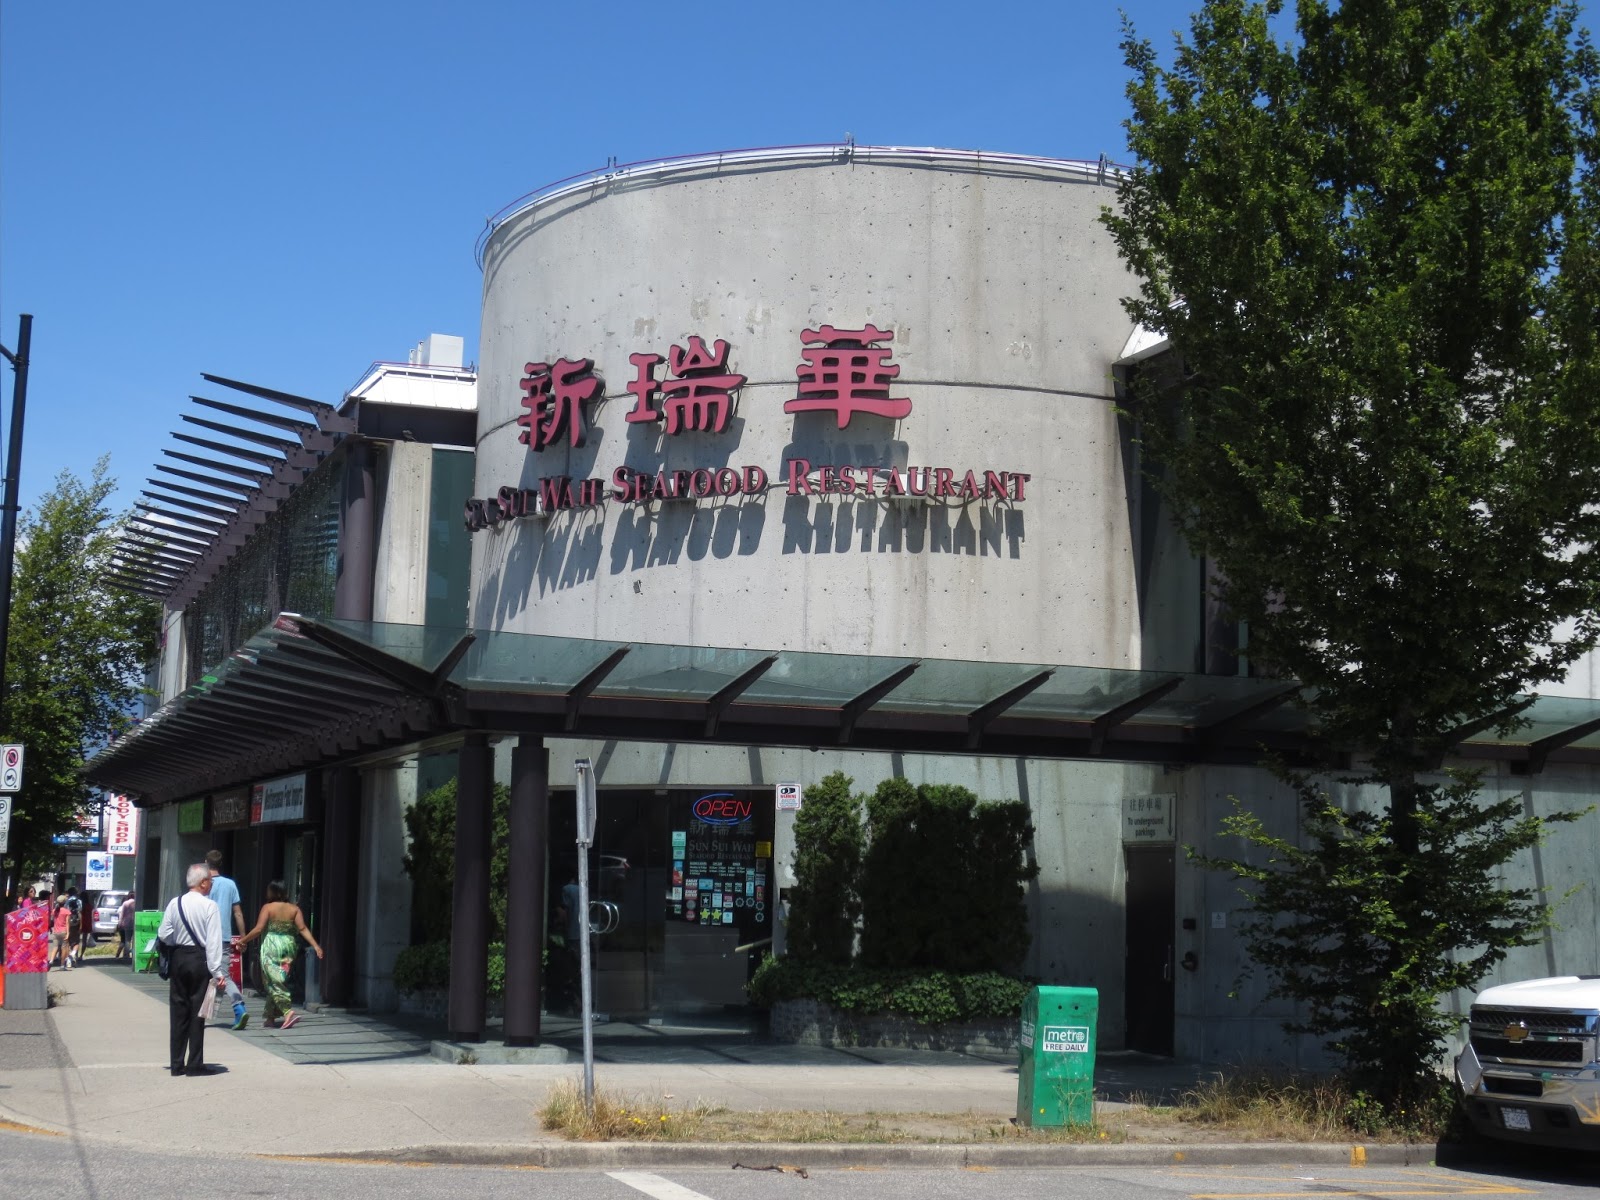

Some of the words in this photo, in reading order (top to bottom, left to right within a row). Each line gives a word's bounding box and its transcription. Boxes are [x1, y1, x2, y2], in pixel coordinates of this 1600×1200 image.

[517, 323, 912, 453] 新瑞華
[497, 486, 538, 521] SUI
[539, 475, 605, 511] WAH
[612, 465, 768, 503] SEAFOOD
[787, 458, 1031, 501] RESTAURANT
[696, 799, 752, 817] OPEN
[1127, 817, 1133, 826] To
[1134, 816, 1164, 827] underground
[115, 821, 129, 844] SHOP
[689, 840, 709, 852] SUN
[711, 840, 728, 852] SUI
[1047, 1029, 1085, 1042] metro
[1045, 1043, 1063, 1051] FREE
[1065, 1043, 1085, 1052] DAILY
